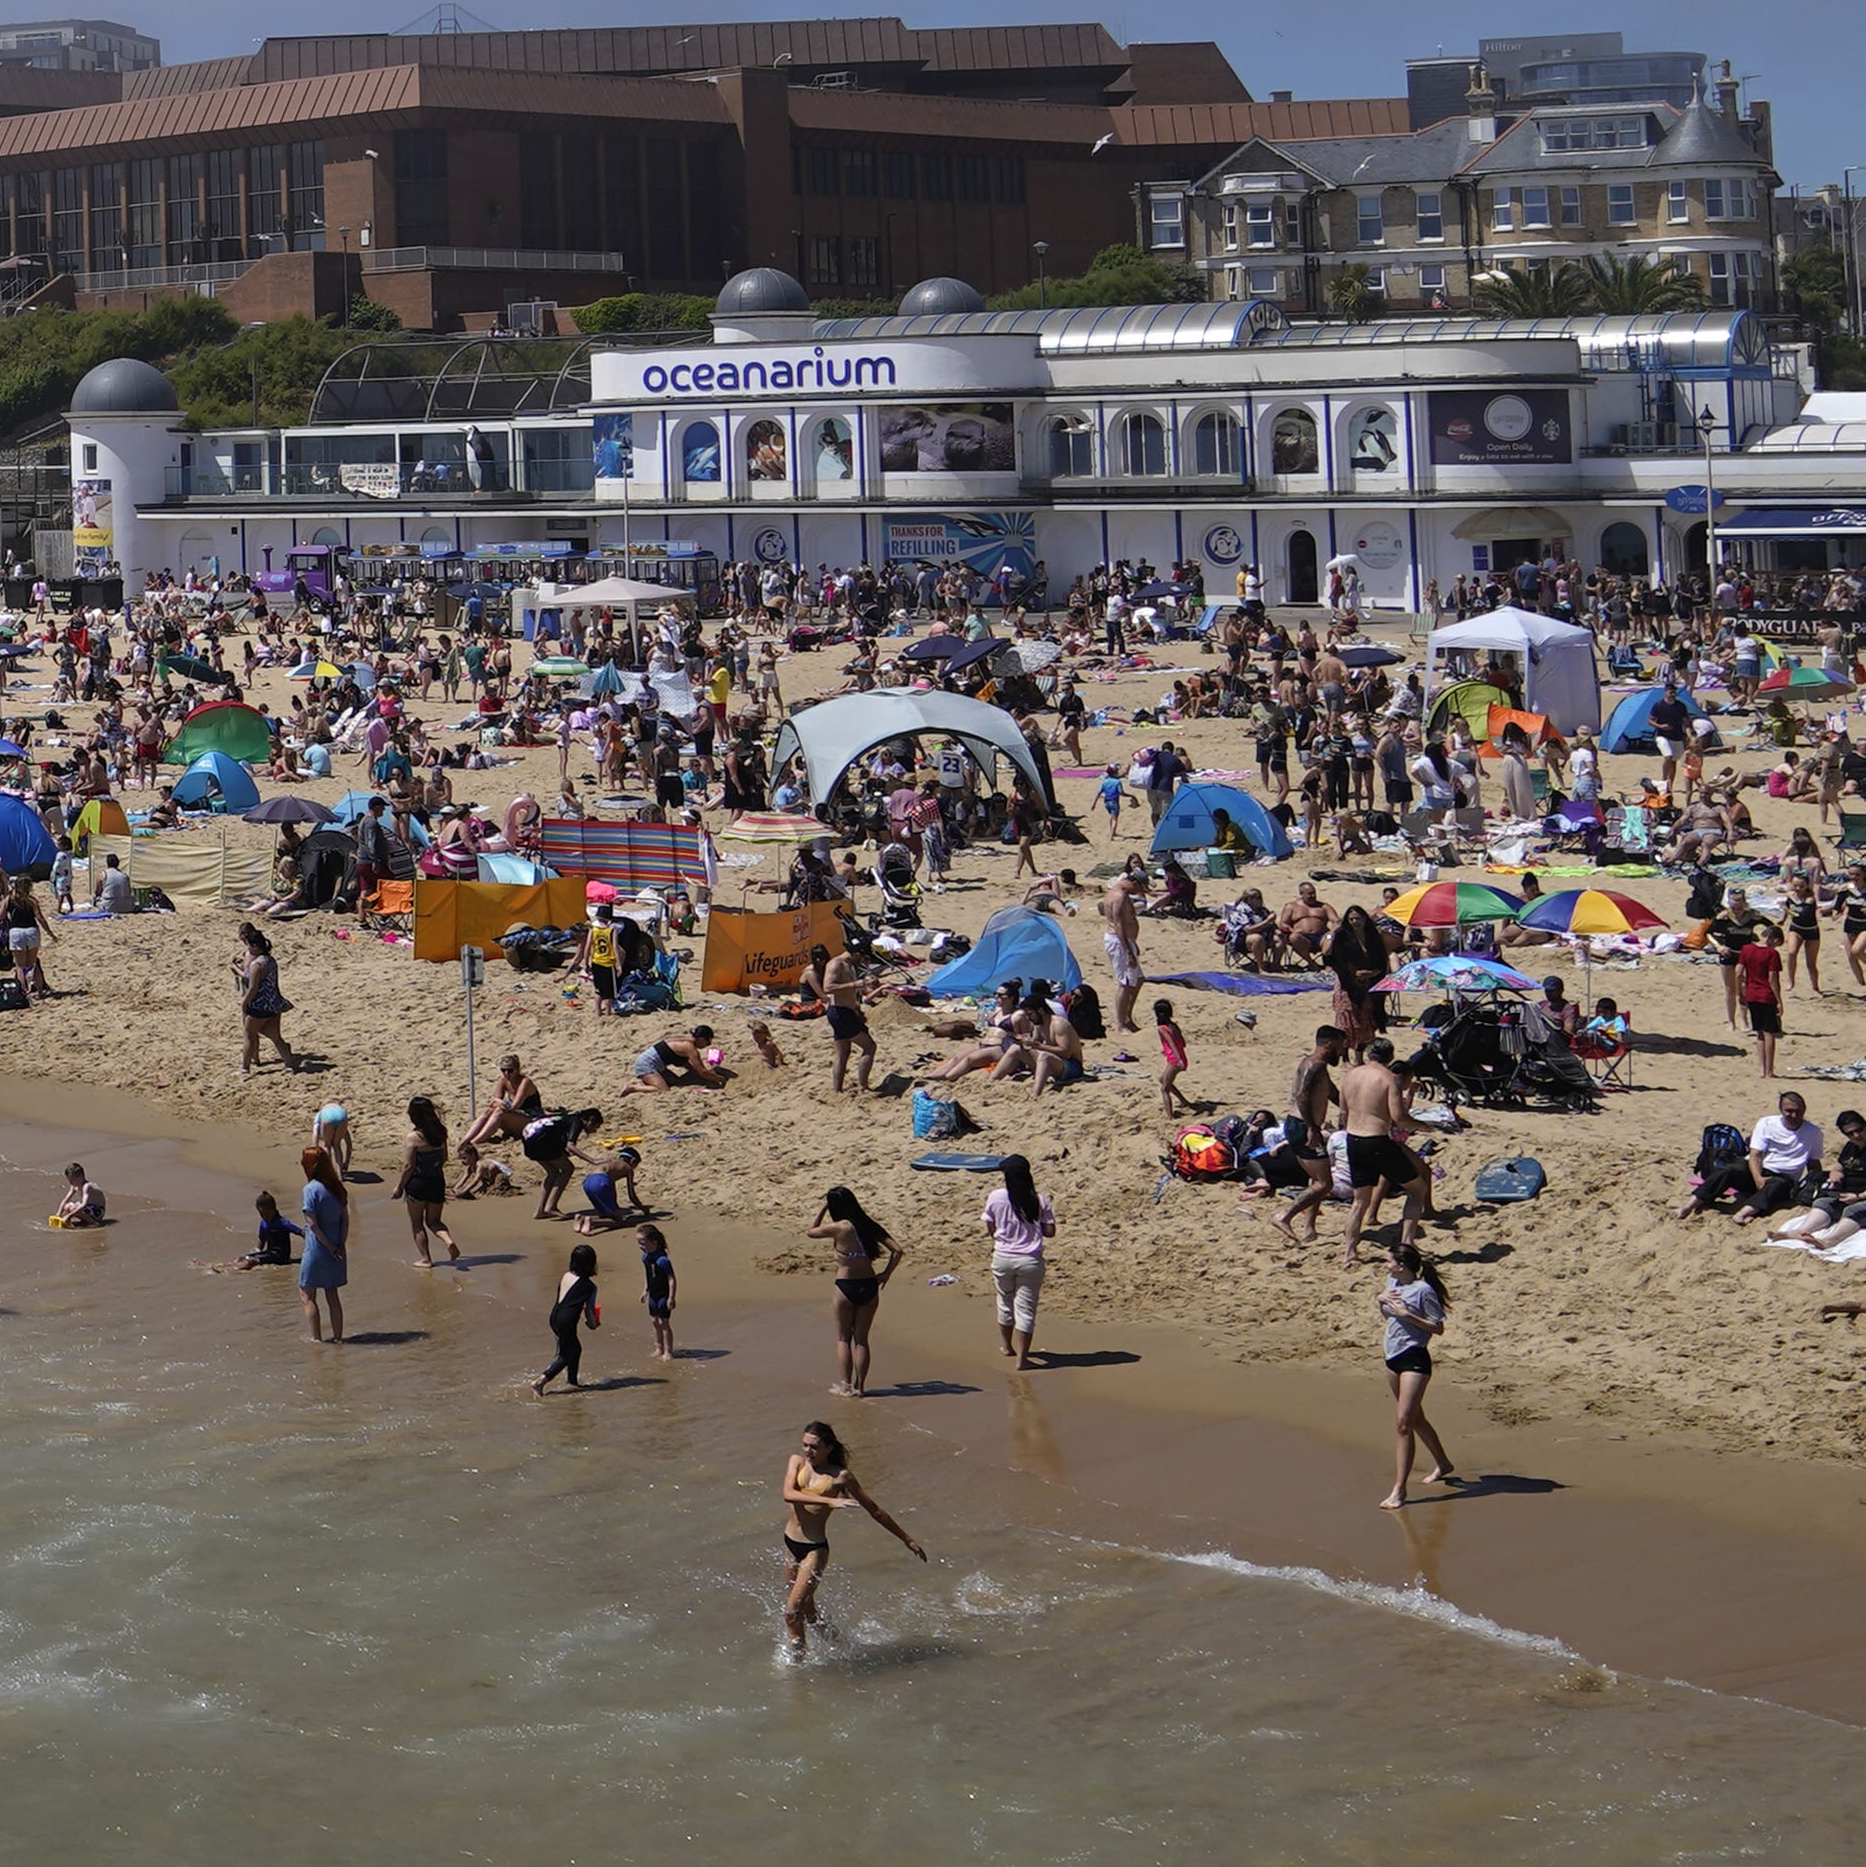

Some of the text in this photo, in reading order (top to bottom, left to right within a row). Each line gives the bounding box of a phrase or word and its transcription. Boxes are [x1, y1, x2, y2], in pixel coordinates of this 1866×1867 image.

[642, 346, 896, 393] oceanarium
[1487, 442, 1533, 452] Open Daily
[1459, 453, 1479, 461] Enjoy
[890, 526, 944, 537] THANKS FOR
[891, 539, 956, 555] REFILLING
[943, 756, 960, 774] 23
[597, 937, 608, 954] 6
[745, 947, 809, 978] Lifeguards
